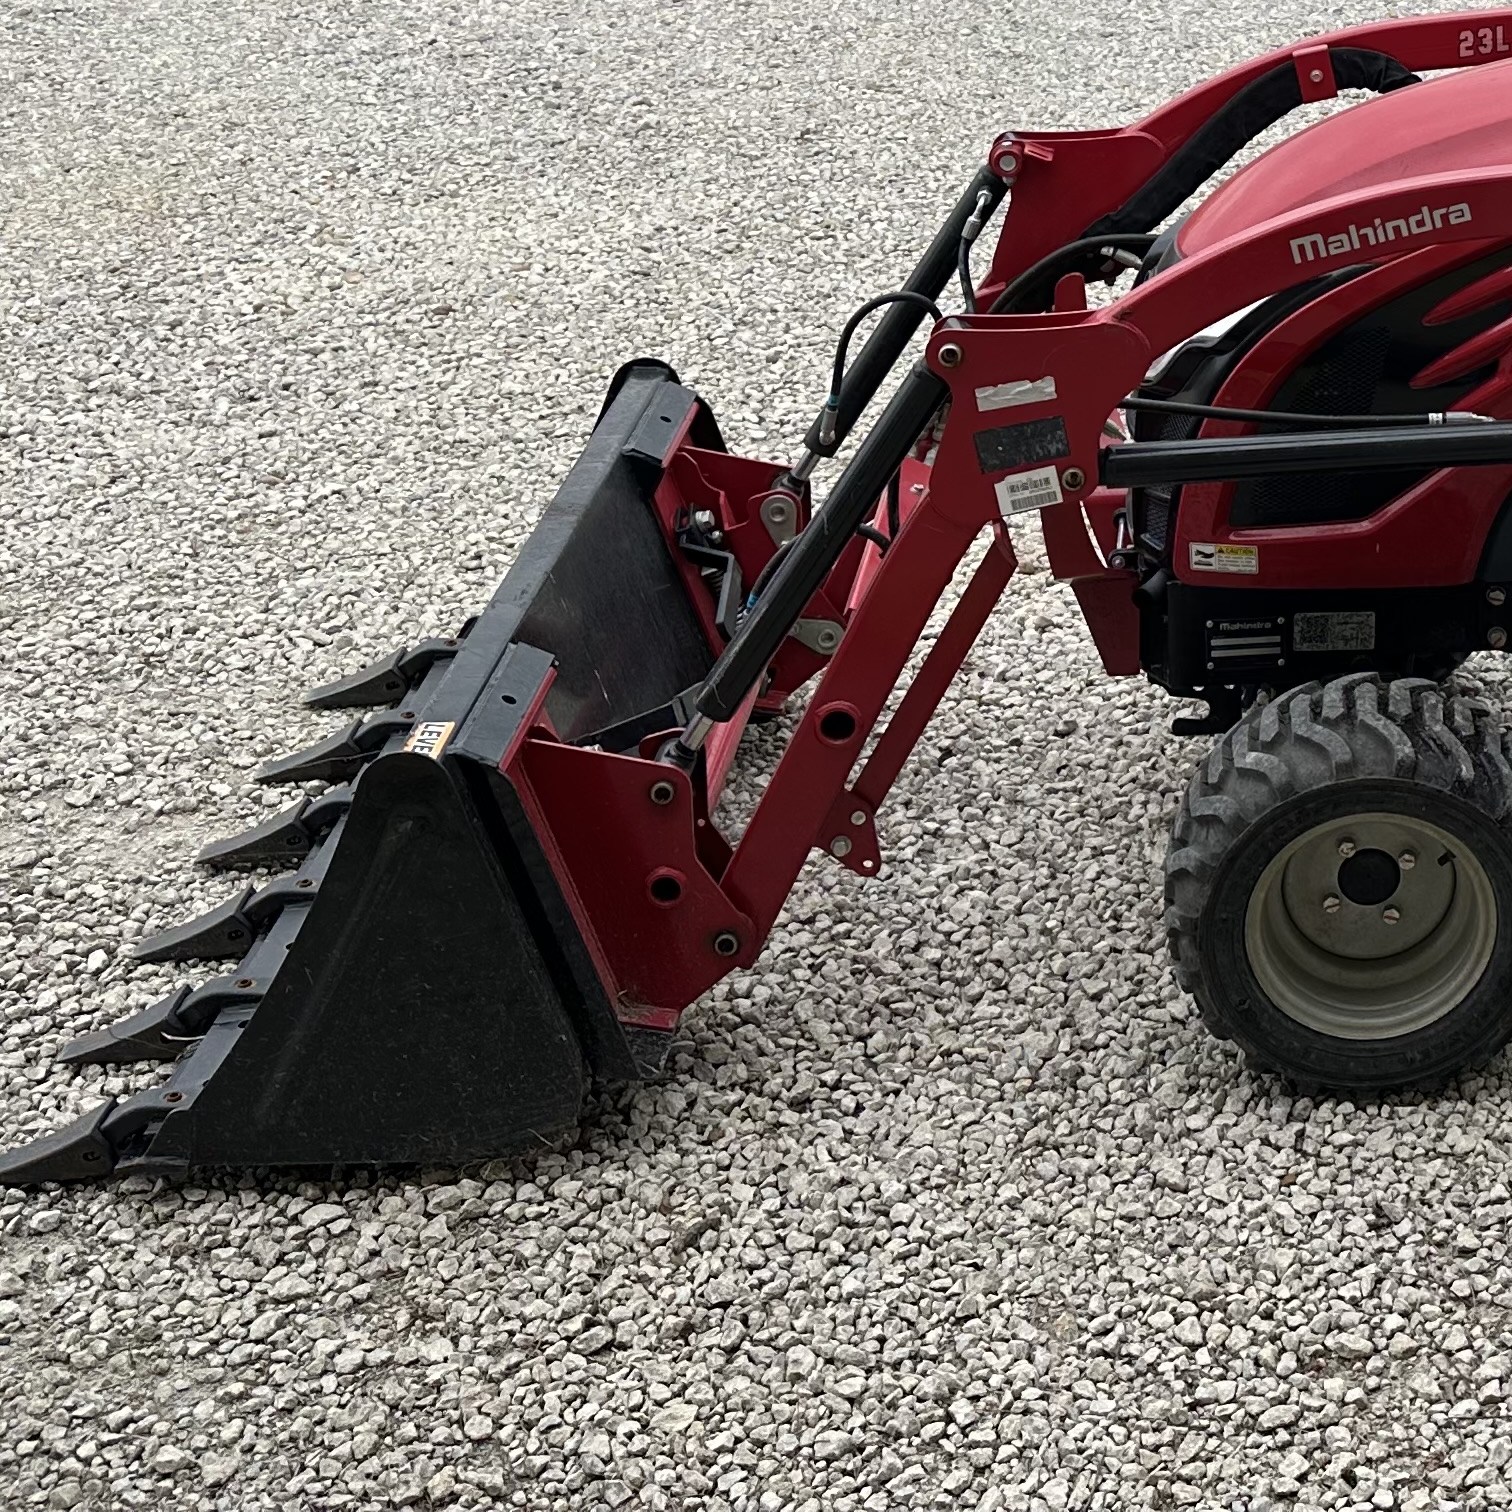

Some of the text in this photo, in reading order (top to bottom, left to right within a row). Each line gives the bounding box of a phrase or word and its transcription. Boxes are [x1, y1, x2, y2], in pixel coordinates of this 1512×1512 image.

[1459, 25, 1510, 58] 23L
[1289, 202, 1472, 265] Mahindra
[1219, 621, 1272, 631] Mahindra
[411, 723, 446, 756] LEVE
